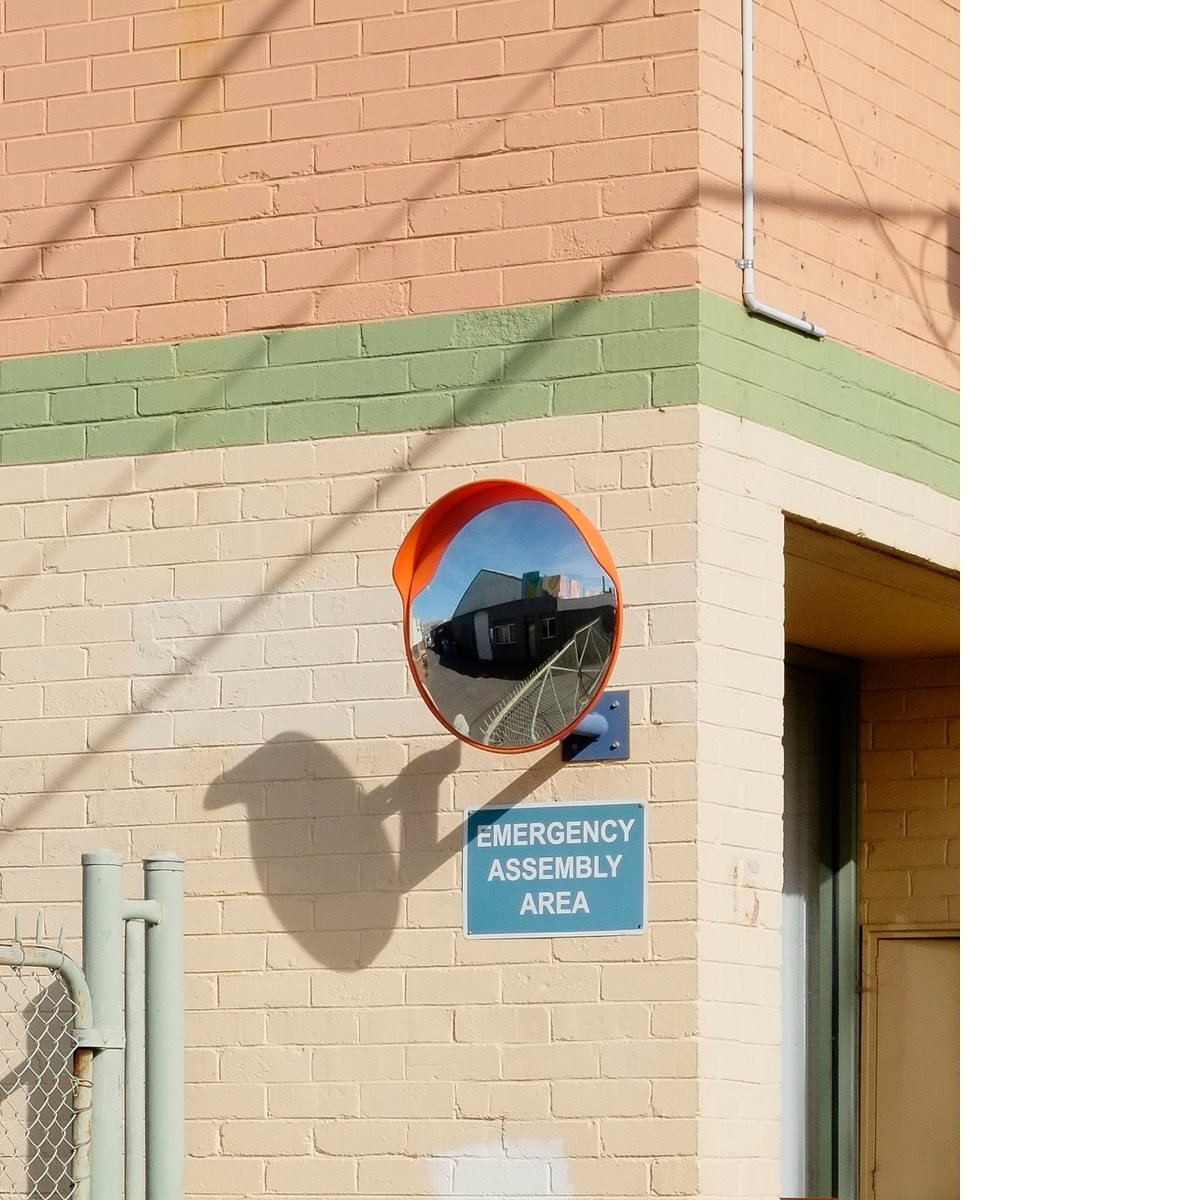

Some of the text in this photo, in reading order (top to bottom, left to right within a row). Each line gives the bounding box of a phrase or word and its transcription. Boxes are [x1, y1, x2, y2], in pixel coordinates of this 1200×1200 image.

[477, 819, 635, 847] EMERGENCY
[487, 854, 623, 881] ASSEMBLY
[519, 891, 590, 915] AREA
